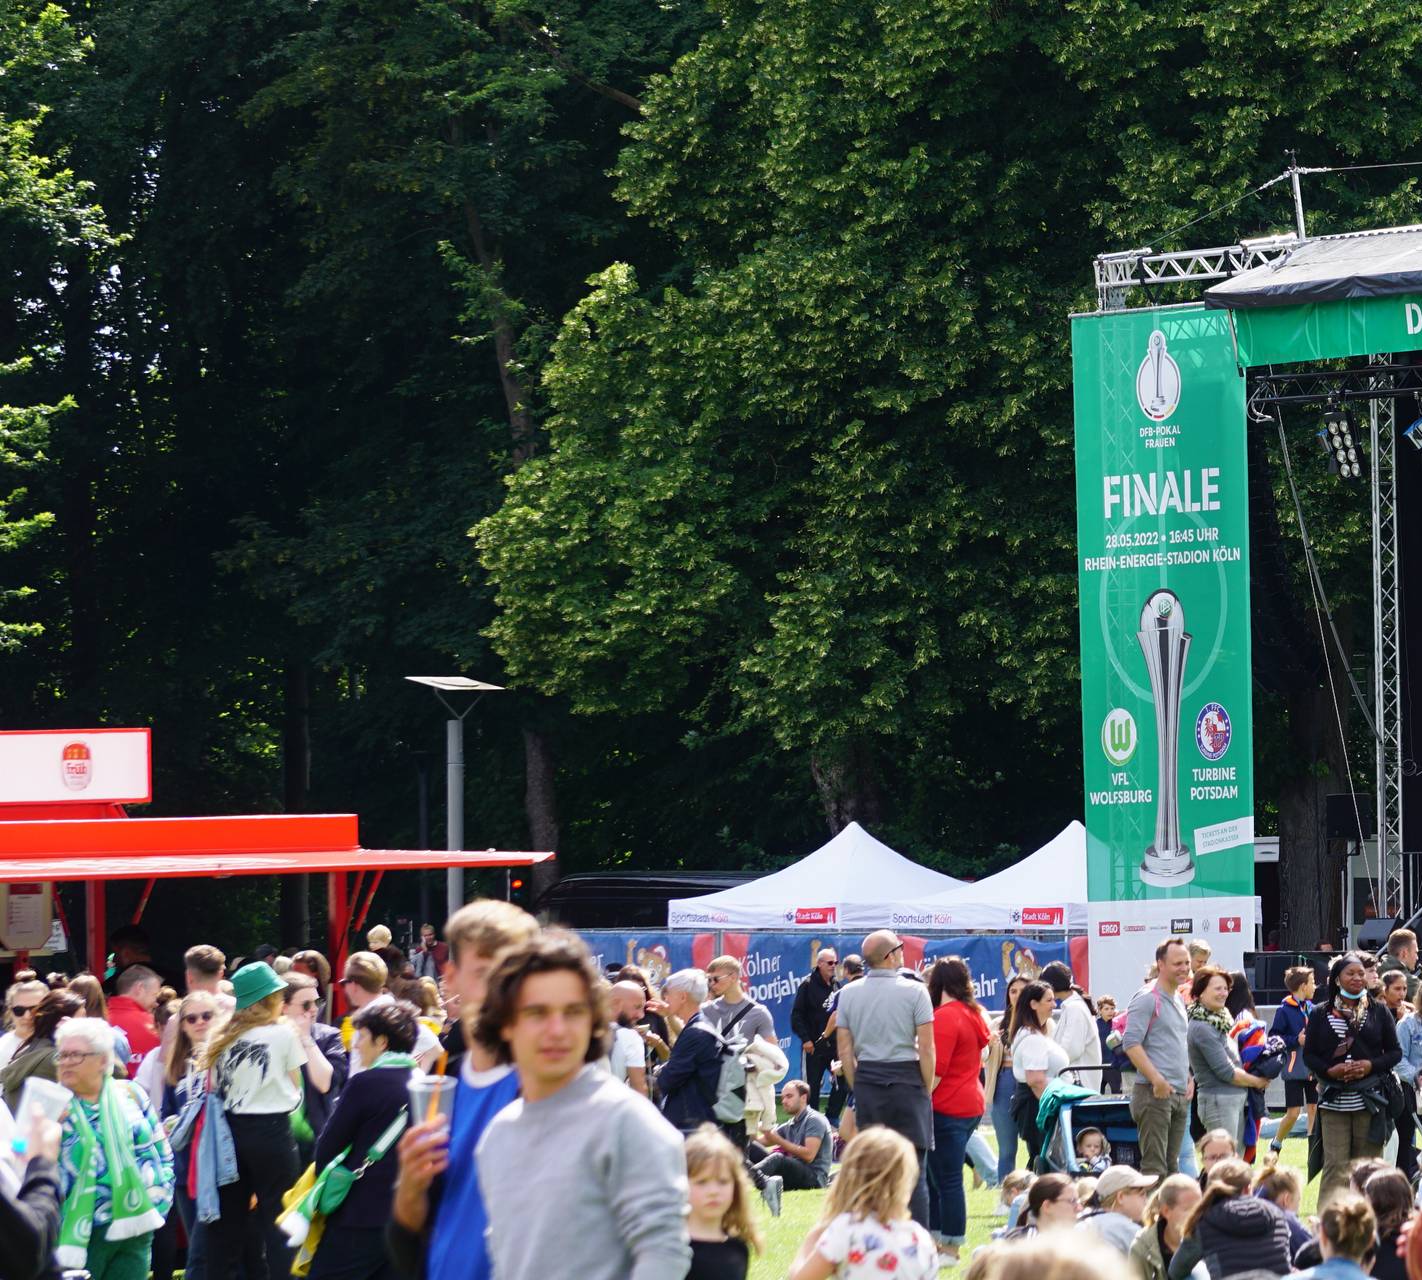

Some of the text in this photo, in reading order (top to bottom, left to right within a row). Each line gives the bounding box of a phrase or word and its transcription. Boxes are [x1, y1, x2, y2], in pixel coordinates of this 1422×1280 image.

[1139, 425, 1181, 438] DFB-POKAL
[1145, 437, 1176, 449] FRAUEN
[1103, 467, 1221, 519] FINALE
[1105, 528, 1219, 549] 28.05.2022 16:45 UHR
[1084, 546, 1241, 571] RHEIN-ENERGIE-STADION KÖLN
[1111, 772, 1130, 786] VFL
[1192, 767, 1236, 782] TURBINE
[1089, 789, 1153, 805] WOLFSBURG
[1190, 785, 1238, 801] POTSDAM
[892, 912, 952, 925] Sportstadt Köln
[1022, 911, 1050, 921] Stadt Köln
[1101, 924, 1118, 935] ERGO
[1173, 919, 1190, 930] bwin
[739, 951, 781, 977] Kölner
[749, 971, 811, 1003] portjah
